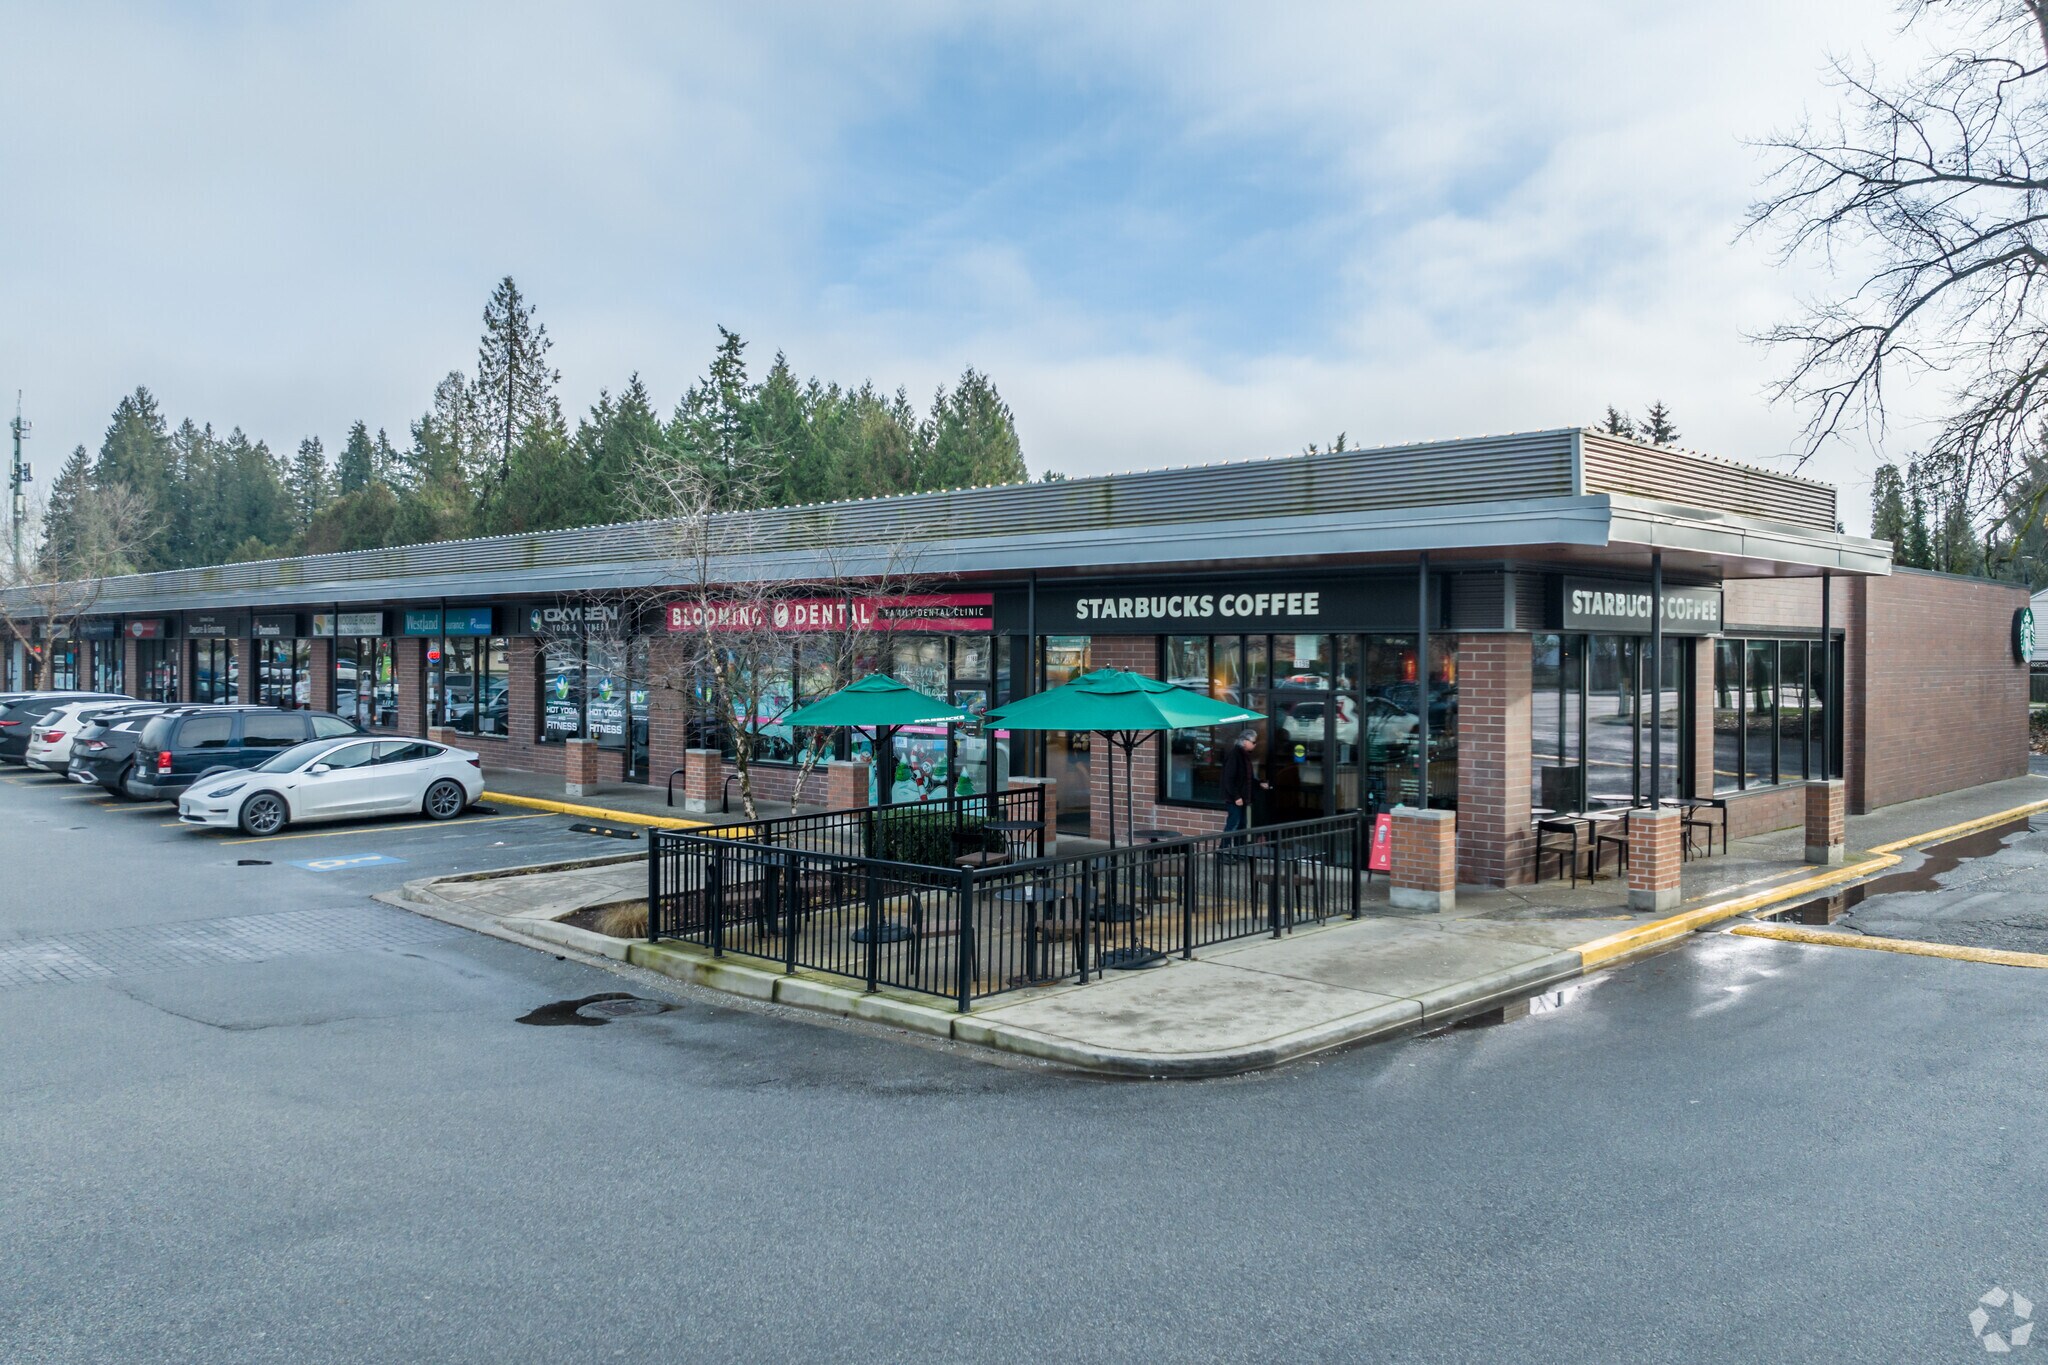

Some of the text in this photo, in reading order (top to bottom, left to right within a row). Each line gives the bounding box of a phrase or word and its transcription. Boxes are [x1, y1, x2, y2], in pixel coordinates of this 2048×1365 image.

[1076, 592, 1319, 620] STARBUCKS COFFEE
[1667, 597, 1717, 621] COFFEE
[543, 606, 618, 622] OXYGEN
[672, 604, 870, 626] BLOOMING DENTAL
[885, 607, 984, 617] FAMILY DENTAL CLINIC
[406, 614, 439, 632] Westland
[552, 624, 570, 632] YOGA
[546, 706, 578, 715] HOT YOGA
[589, 708, 622, 718] HOT YOGA
[546, 721, 578, 732] FITNESS
[589, 724, 622, 735] FITNESS
